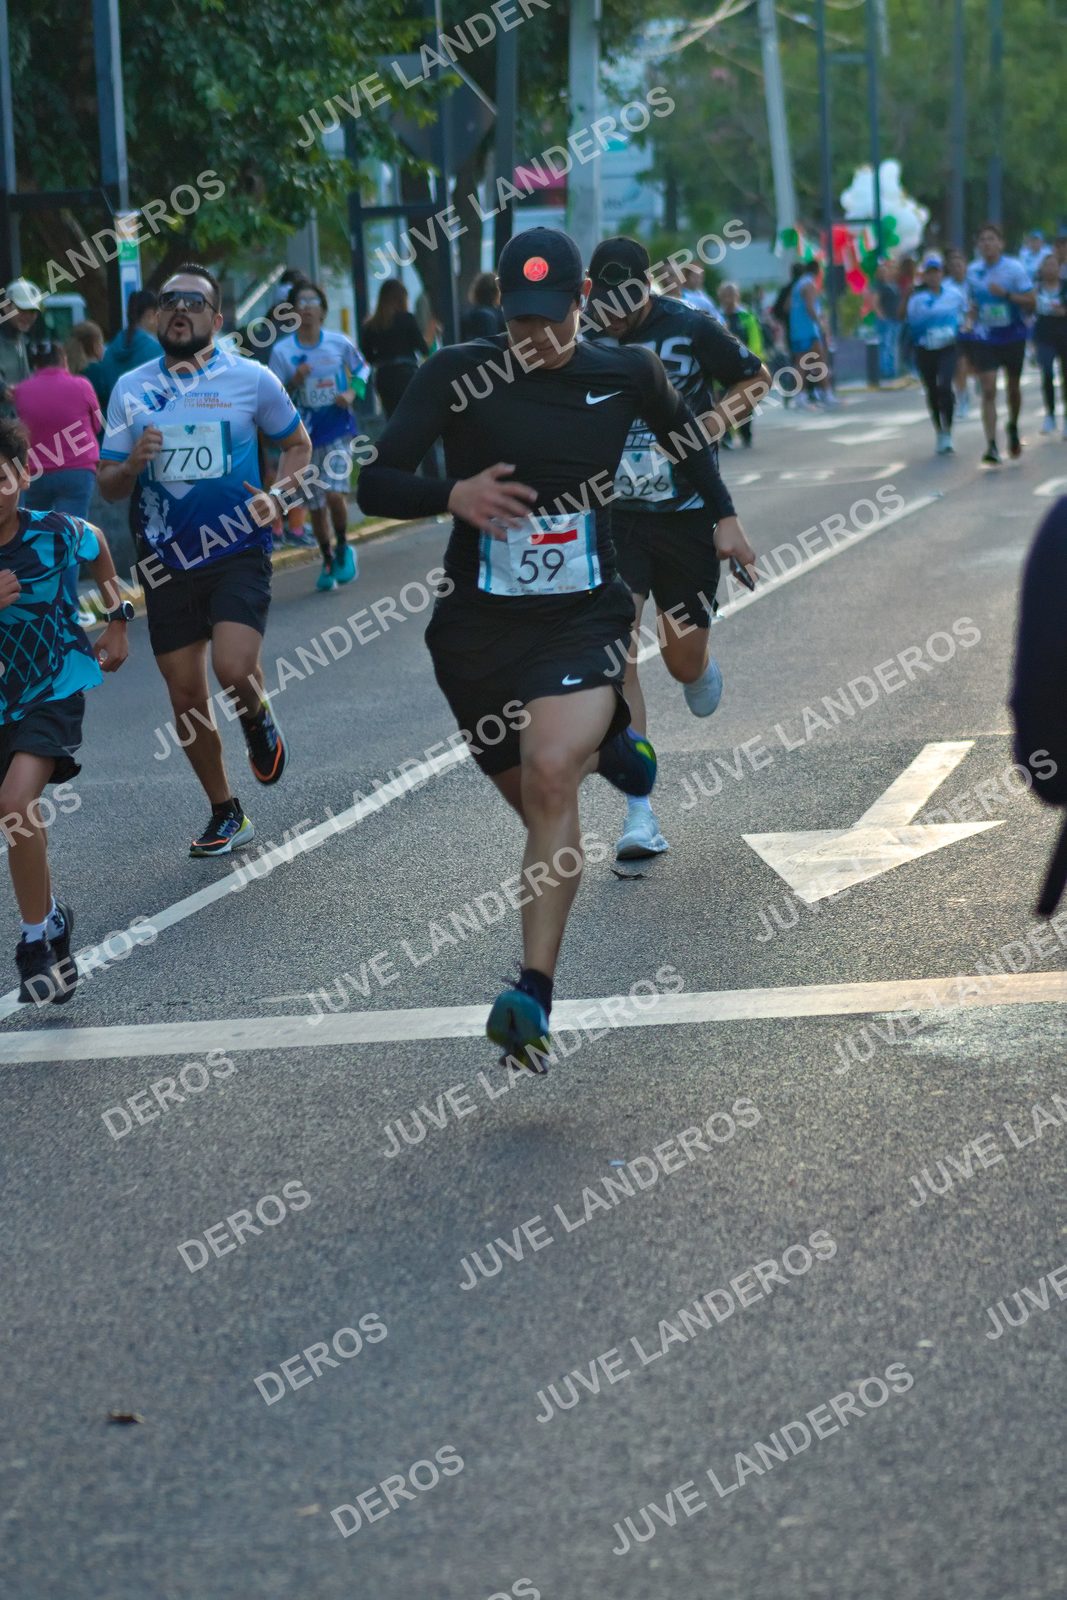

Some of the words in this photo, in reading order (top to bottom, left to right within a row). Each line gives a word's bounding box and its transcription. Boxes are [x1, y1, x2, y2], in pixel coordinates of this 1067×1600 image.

[161, 446, 212, 473] 770
[619, 474, 669, 497] 326
[517, 548, 565, 585] 59
